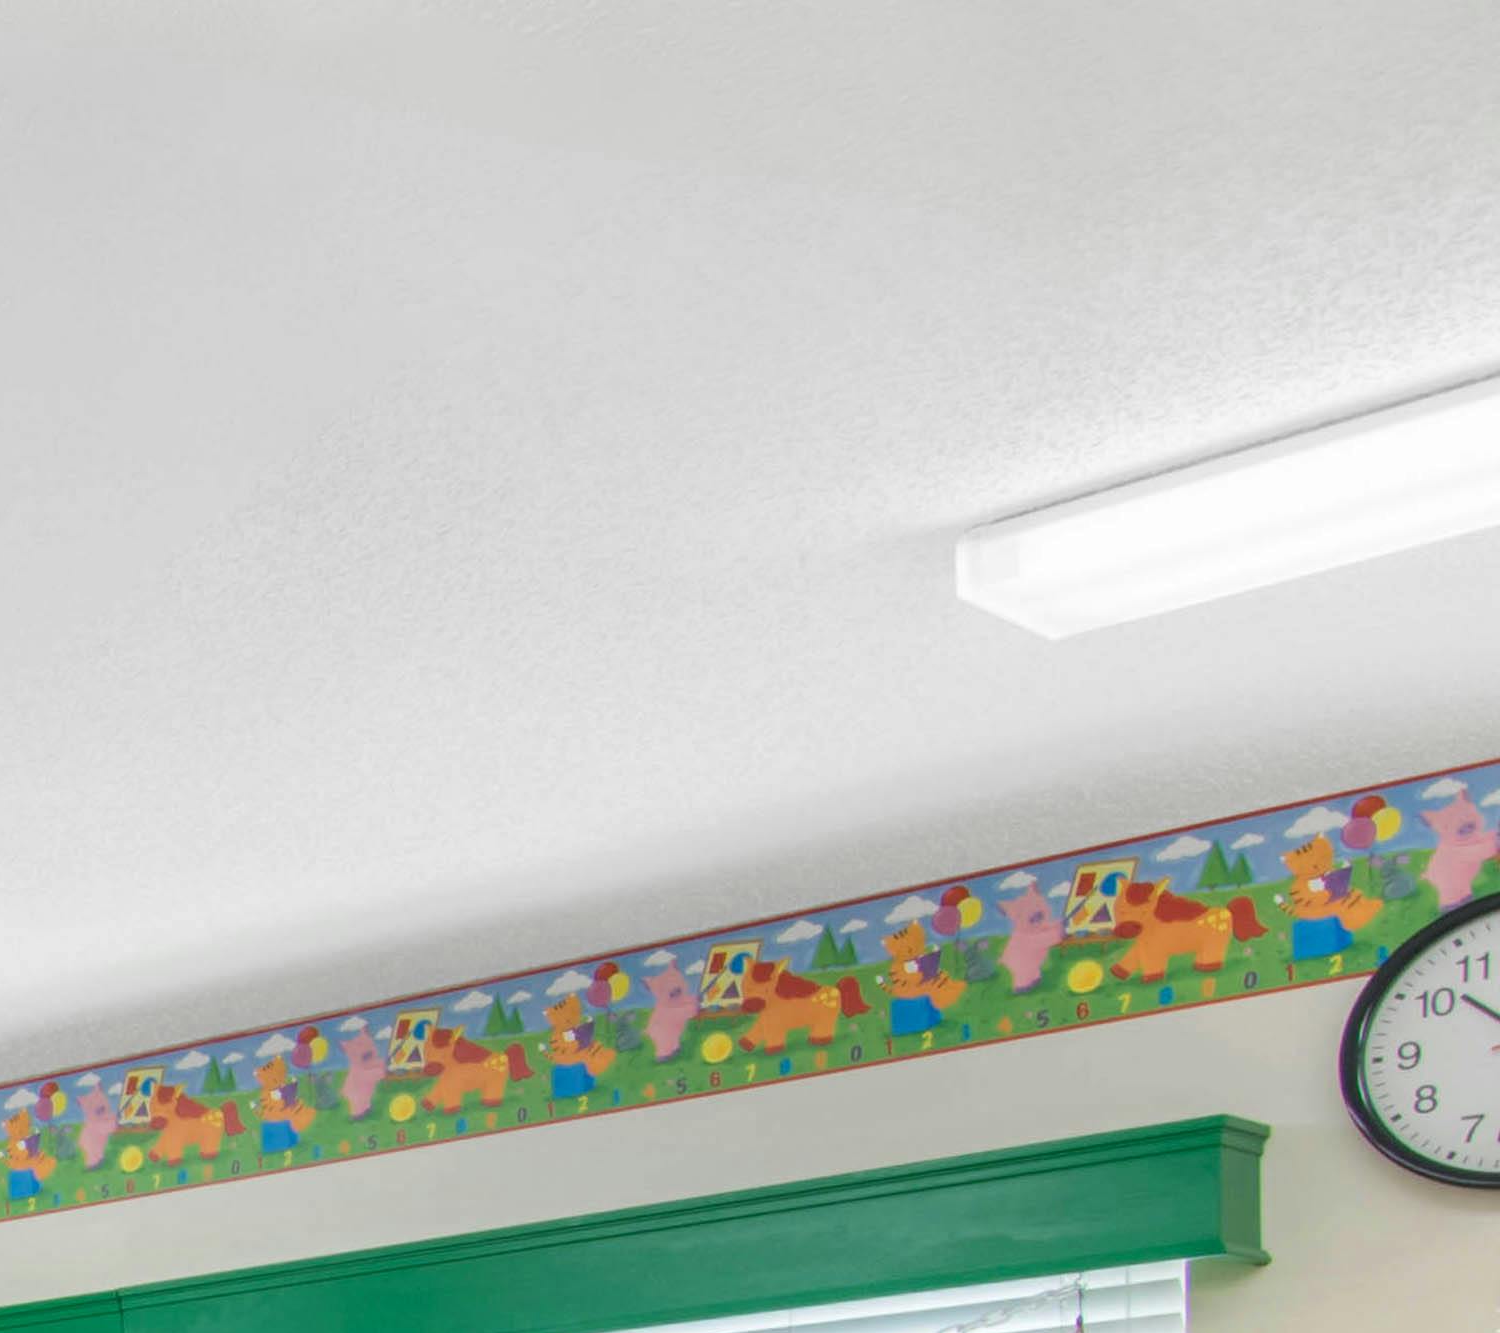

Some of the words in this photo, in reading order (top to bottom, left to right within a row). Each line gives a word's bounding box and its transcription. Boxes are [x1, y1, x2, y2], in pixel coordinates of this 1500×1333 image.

[1244, 971, 1257, 988] 0
[1287, 963, 1295, 982] 1
[1329, 954, 1343, 976] 2
[1456, 952, 1490, 983] 11
[1415, 987, 1456, 1018] 10
[1398, 1041, 1421, 1070] 9
[1414, 1084, 1438, 1114] 8
[1461, 1114, 1484, 1143] 7
